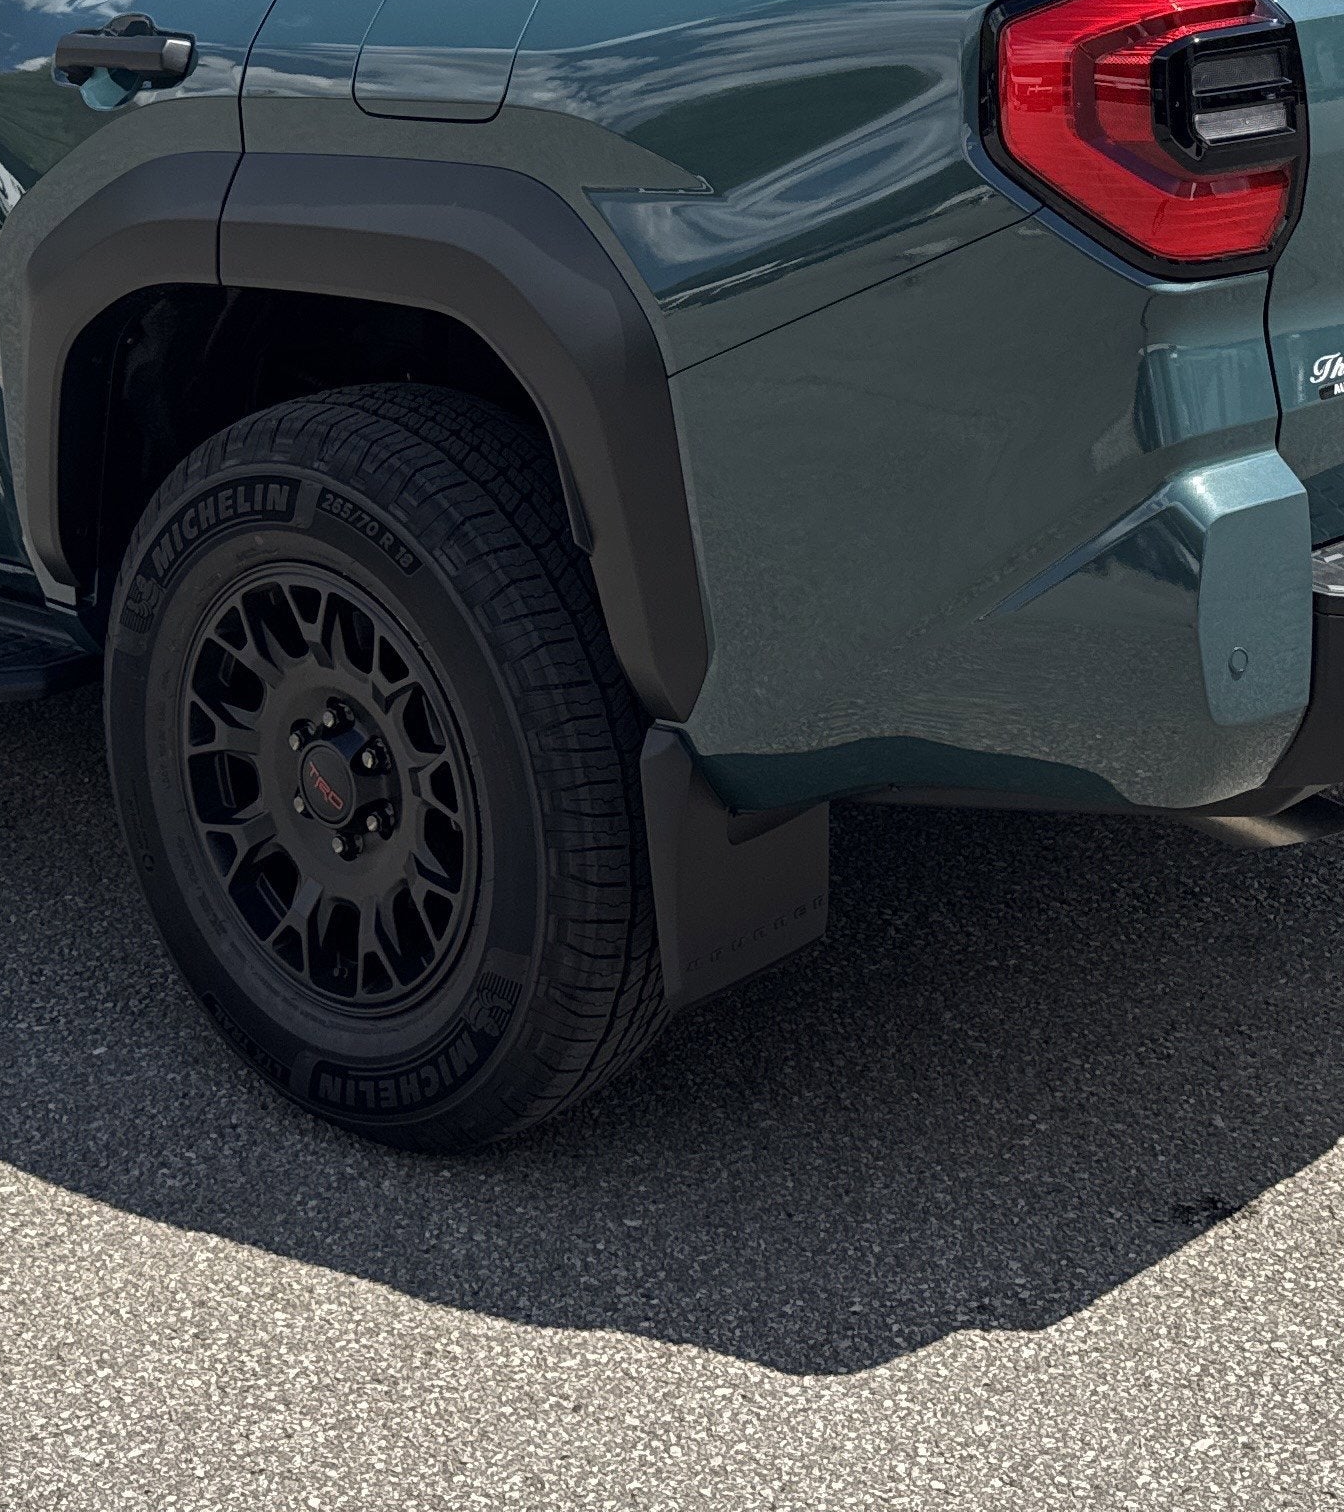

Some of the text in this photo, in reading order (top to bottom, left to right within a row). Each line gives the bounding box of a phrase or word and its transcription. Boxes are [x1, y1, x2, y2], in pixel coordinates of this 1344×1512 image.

[150, 482, 291, 578] MICHELIN
[322, 493, 415, 569] 265/70 R 18
[309, 761, 345, 811] TRD
[317, 1028, 479, 1109] MICHELIN
